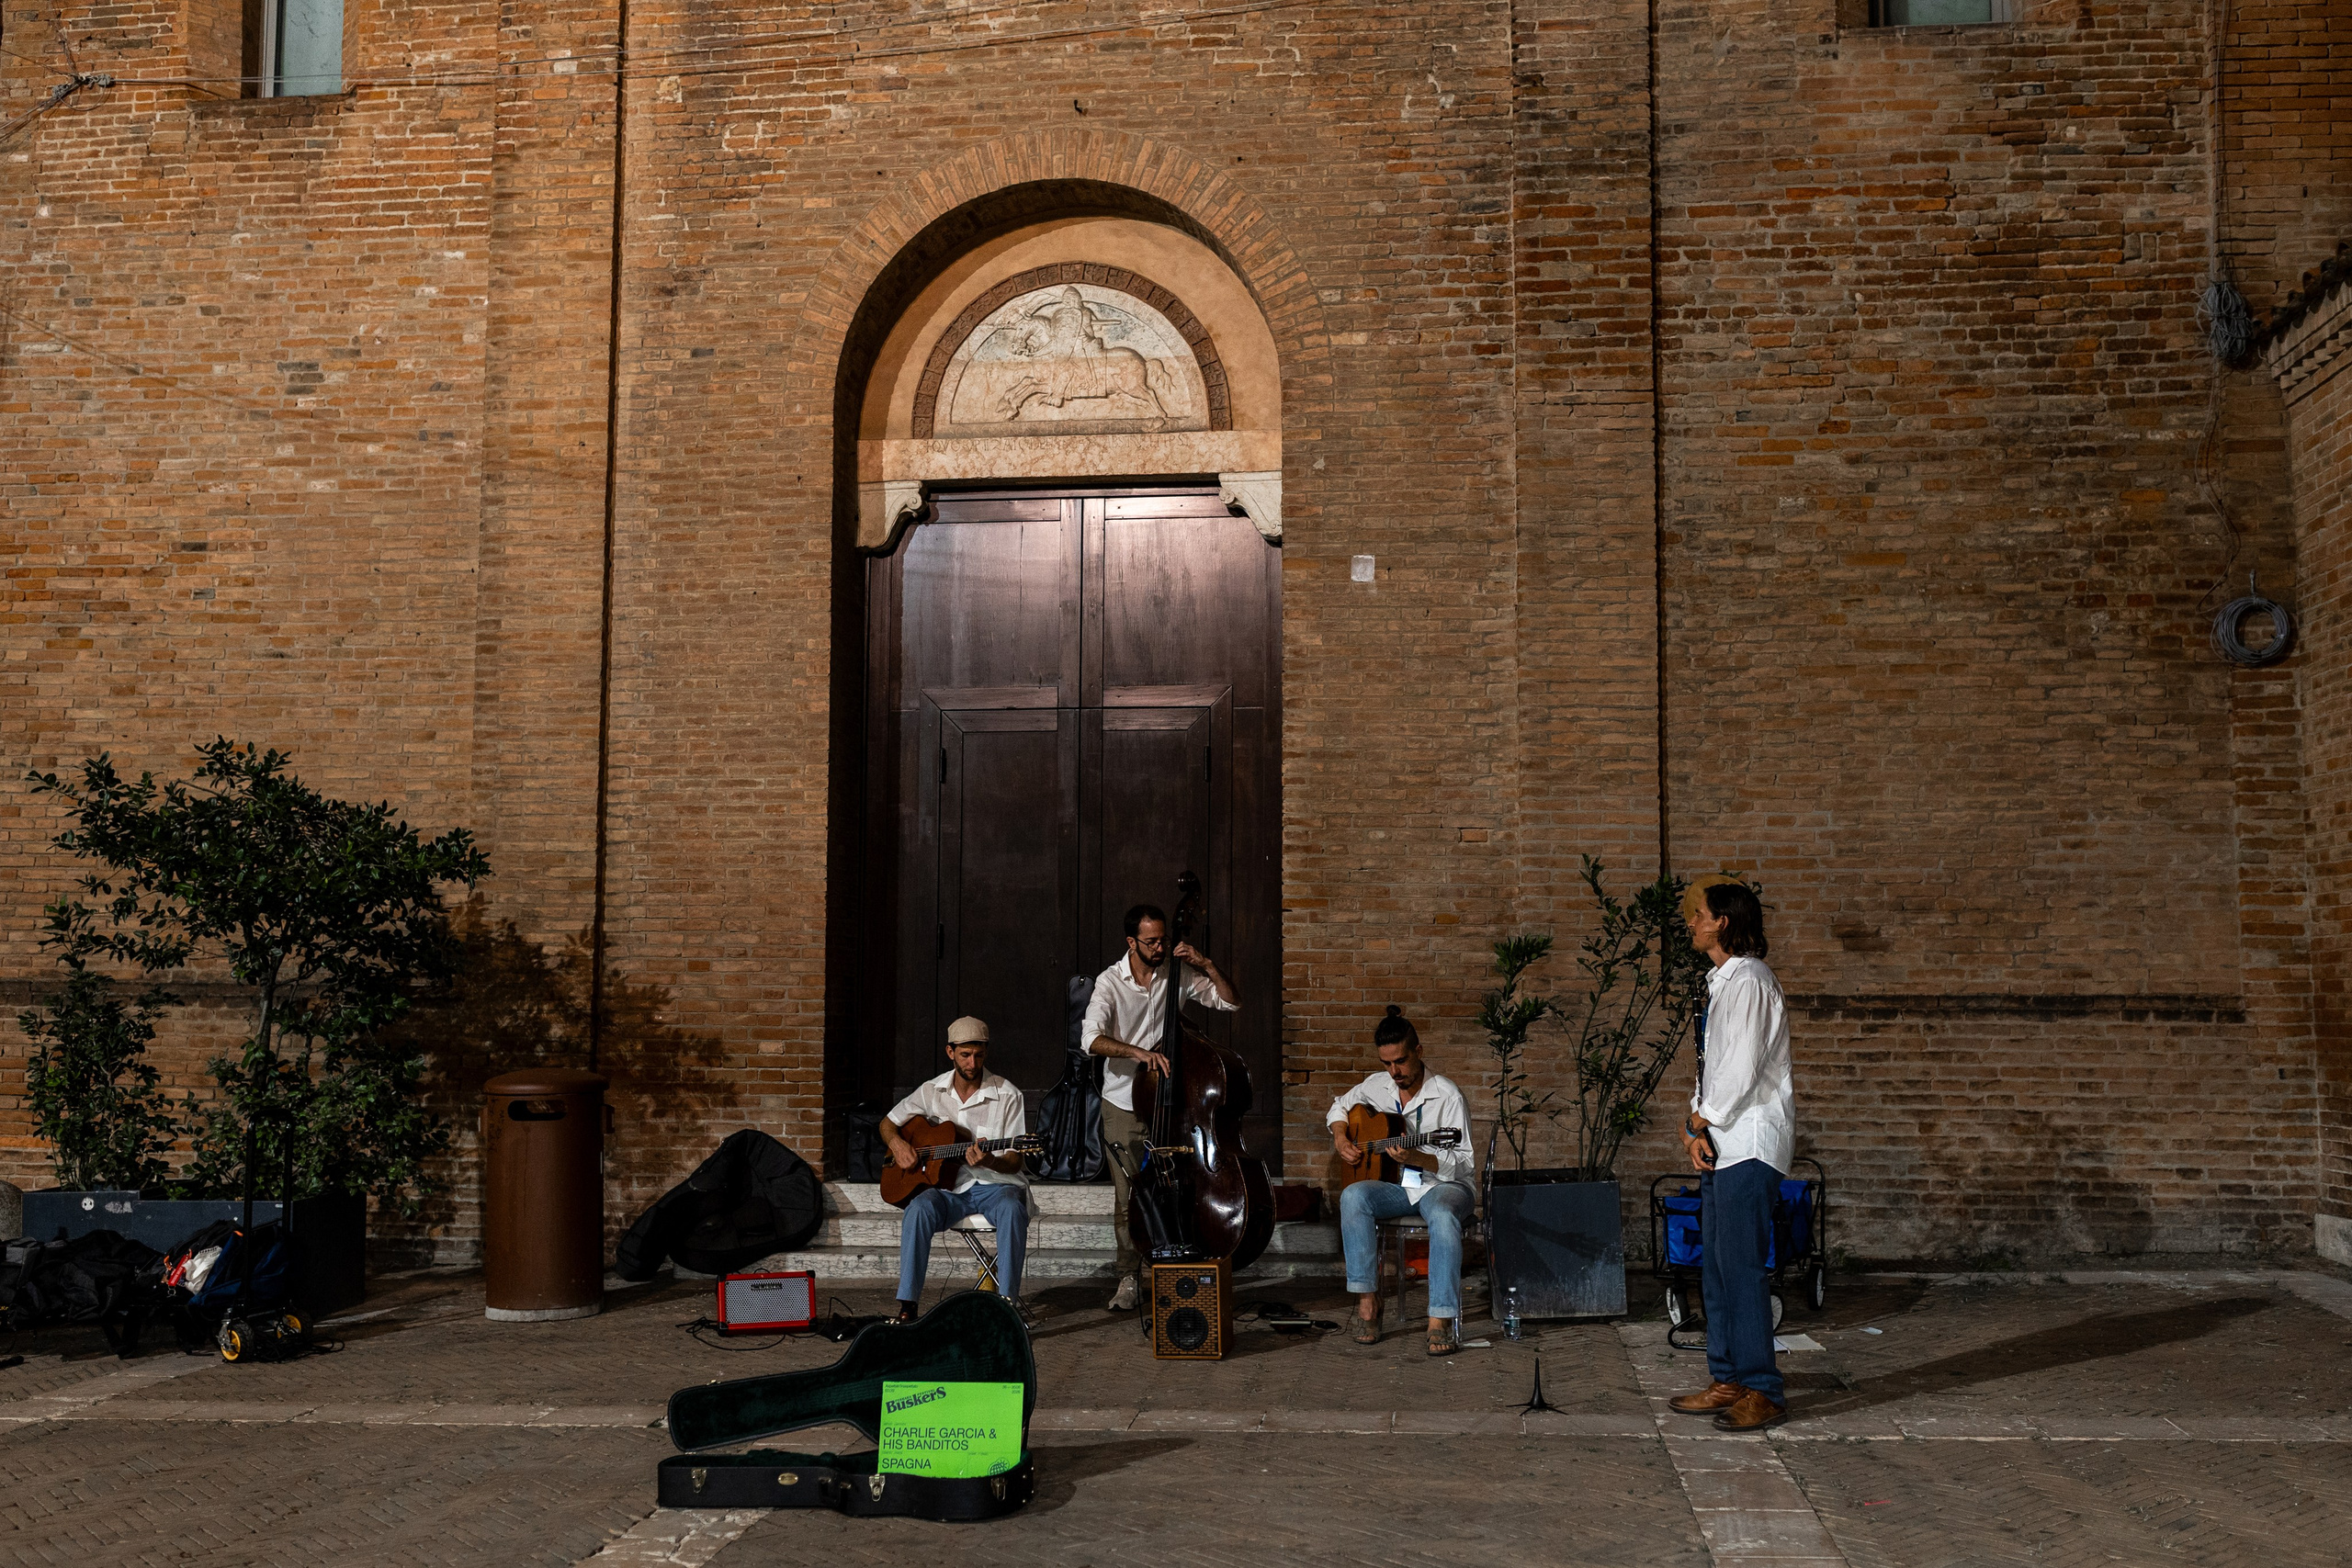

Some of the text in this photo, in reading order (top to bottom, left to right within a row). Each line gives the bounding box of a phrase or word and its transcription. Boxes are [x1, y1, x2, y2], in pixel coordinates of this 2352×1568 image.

[883, 1427, 997, 1439] CHARLIE GARCIA &
[883, 1438, 969, 1451] HIS BANDITOS
[881, 1458, 932, 1470] SPAGNA
